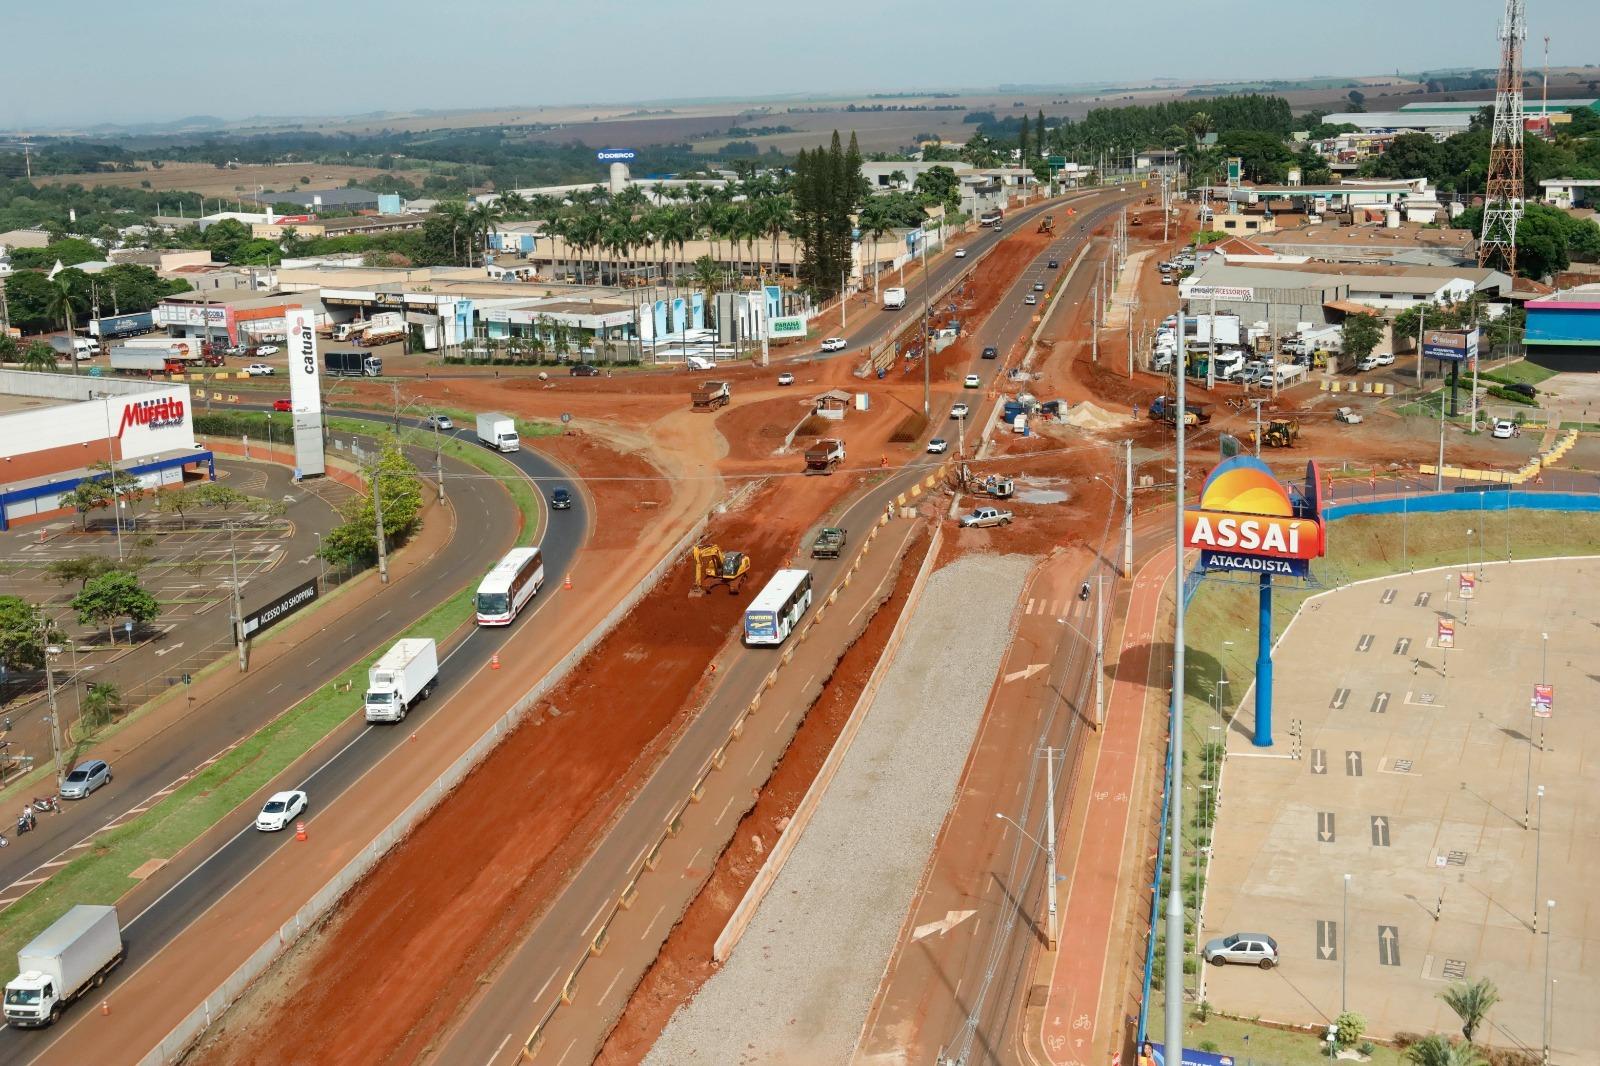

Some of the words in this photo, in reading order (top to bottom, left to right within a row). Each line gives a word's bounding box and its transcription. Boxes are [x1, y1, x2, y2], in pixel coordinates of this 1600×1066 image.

[1209, 555, 1292, 573] ATACADISTA
[260, 606, 281, 625] ACESSO
[280, 601, 289, 613] AO
[288, 586, 314, 608] SHOPPING
